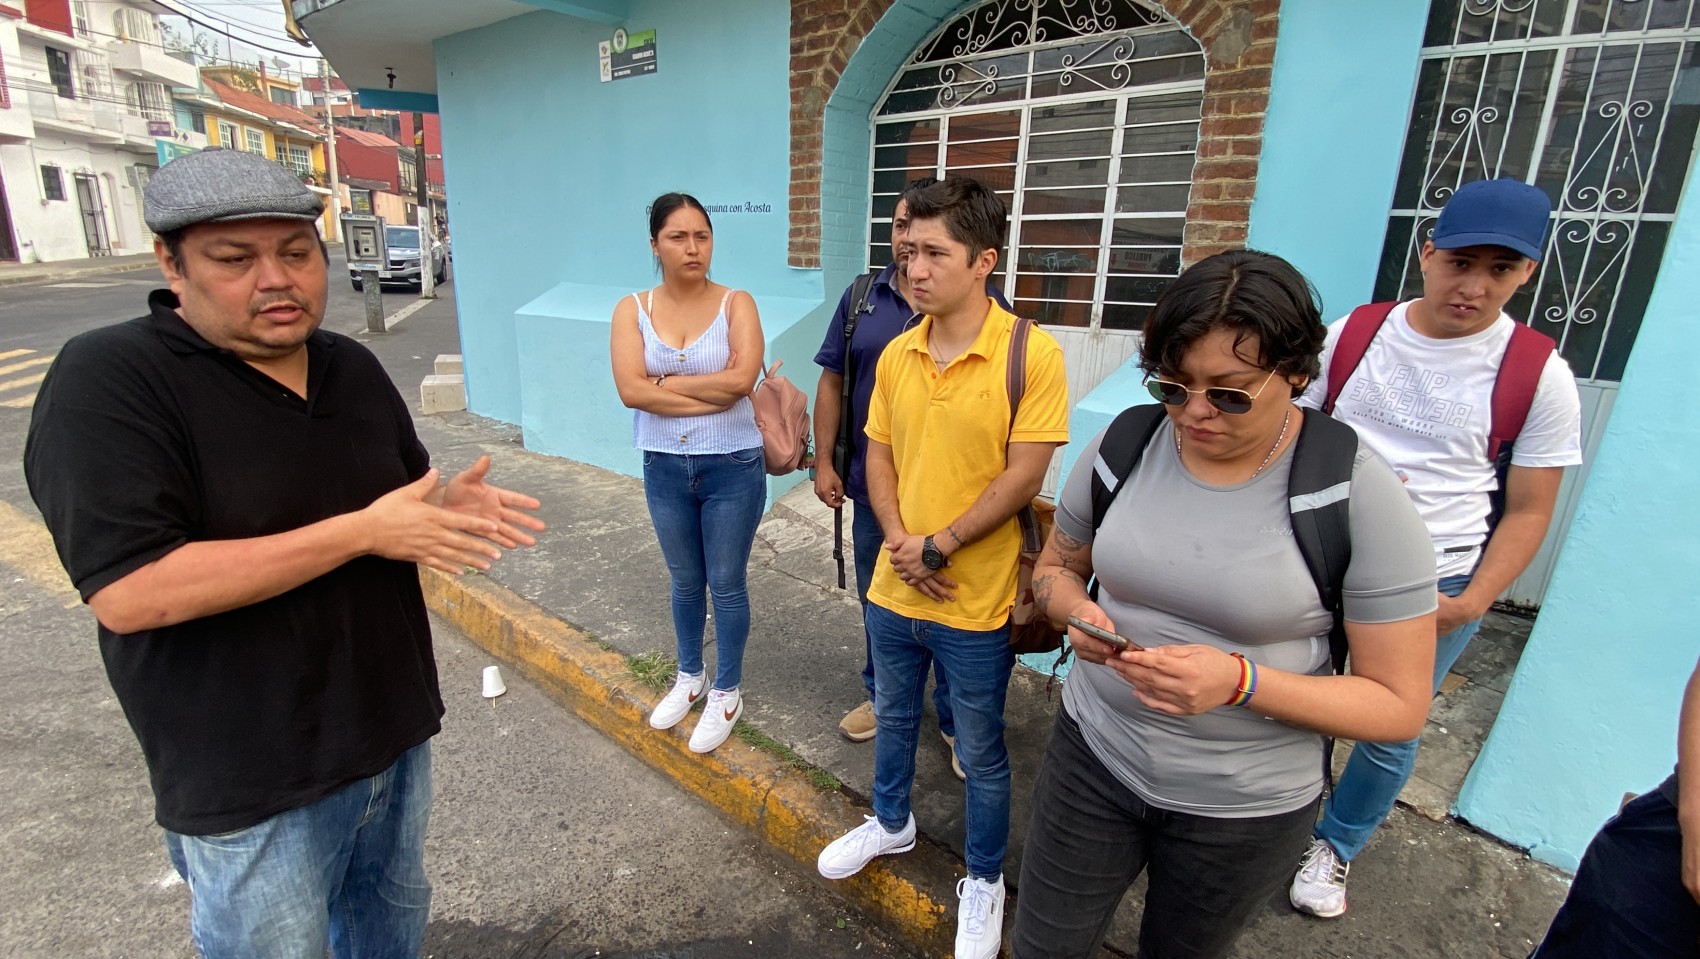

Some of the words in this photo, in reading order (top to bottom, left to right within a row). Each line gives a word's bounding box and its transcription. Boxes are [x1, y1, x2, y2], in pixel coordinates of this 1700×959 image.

[704, 202, 728, 216] squina
[729, 204, 743, 213] con
[744, 201, 771, 213] Acosta
[1387, 364, 1449, 394] FLIP
[1368, 408, 1395, 420] DON'T
[1401, 418, 1434, 430] WORRY
